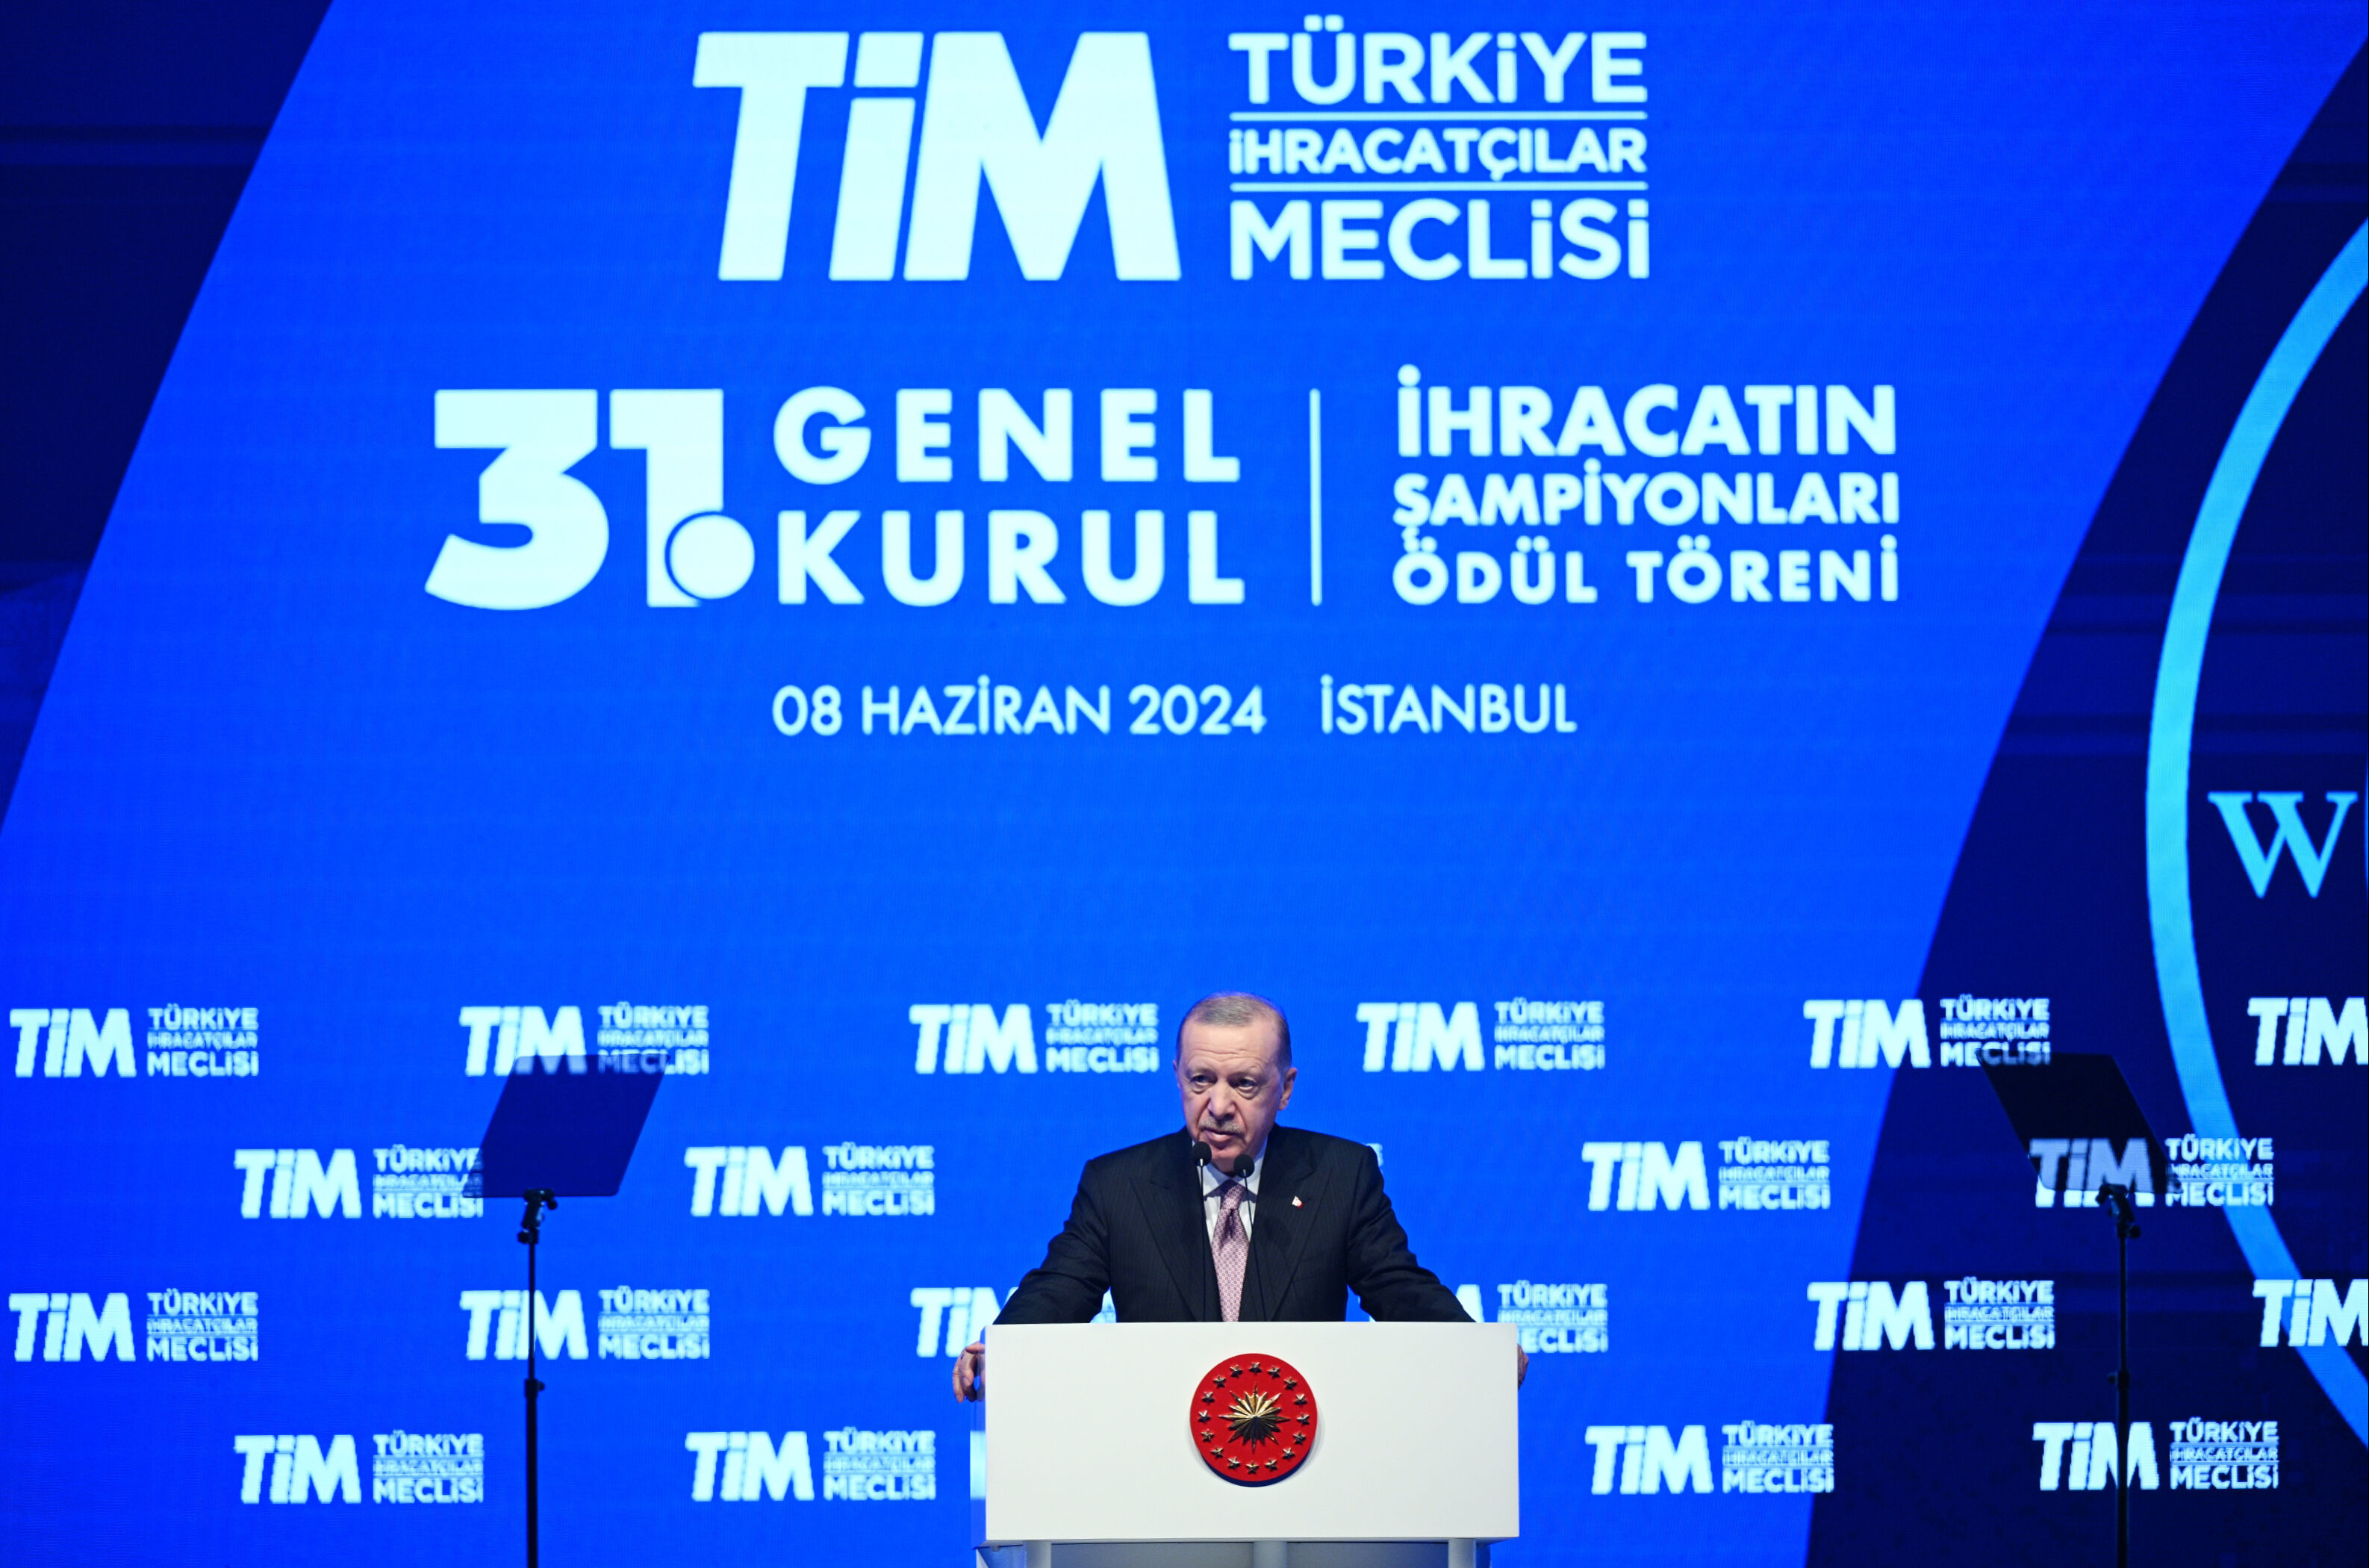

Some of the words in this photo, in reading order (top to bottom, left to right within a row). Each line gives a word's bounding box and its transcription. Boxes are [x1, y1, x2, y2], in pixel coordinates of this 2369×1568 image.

[773, 386, 1240, 485] GENEL
[1398, 364, 1896, 457] İHRACATIN
[425, 388, 755, 610] 31.
[1392, 458, 1899, 539] ŞAMPİYONLARI
[778, 509, 1245, 607] KURUL
[1392, 534, 1598, 606] ÖDÜL
[1626, 534, 1898, 603] TÖRENİ
[772, 685, 842, 736] 08
[862, 674, 1111, 735] HAZİRAN
[1128, 684, 1267, 735] 2024
[1320, 674, 1578, 735] İSTANBUL
[2208, 794, 2356, 896] W
